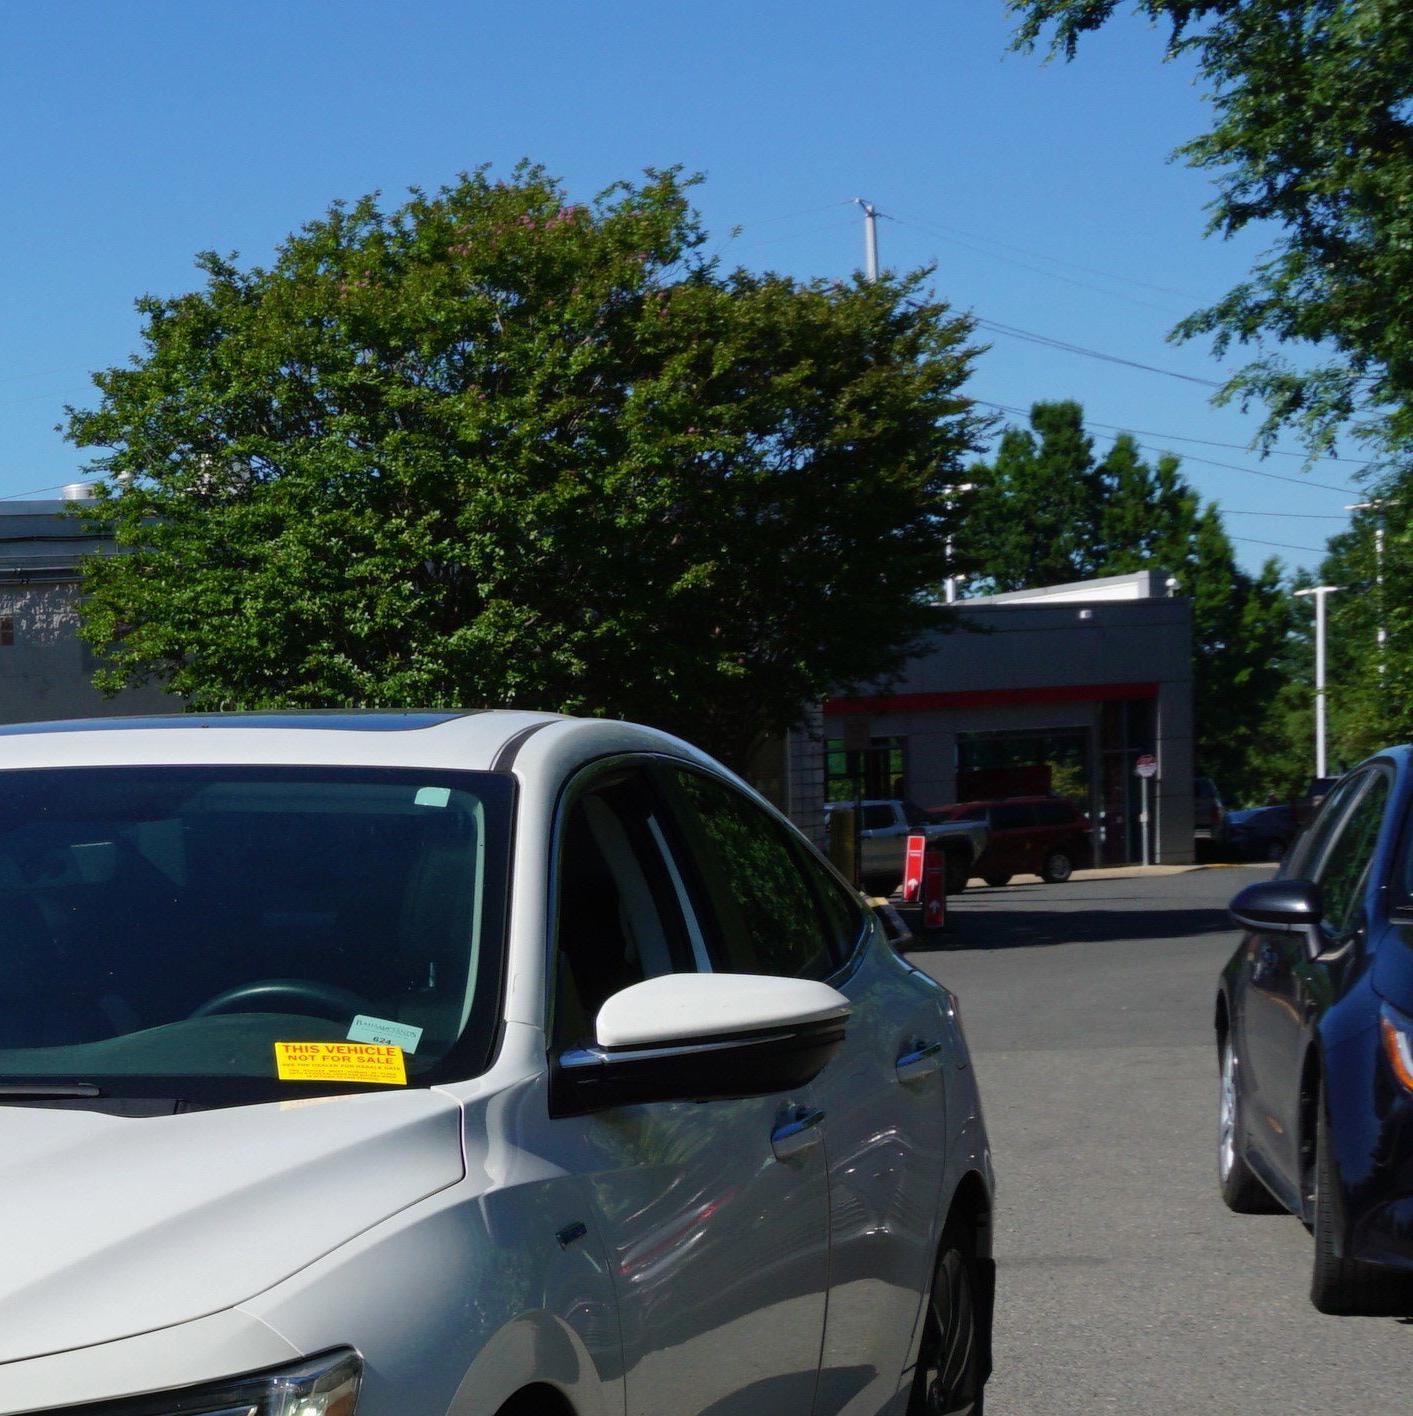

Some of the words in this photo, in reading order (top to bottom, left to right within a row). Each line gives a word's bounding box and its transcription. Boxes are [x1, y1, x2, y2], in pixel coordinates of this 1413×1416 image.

[373, 1036, 392, 1045] 624
[282, 1044, 320, 1054] THIS
[325, 1045, 396, 1057] VEHICLE
[288, 1054, 315, 1062] NOT
[322, 1055, 351, 1063] FOR
[357, 1056, 394, 1065] SALE
